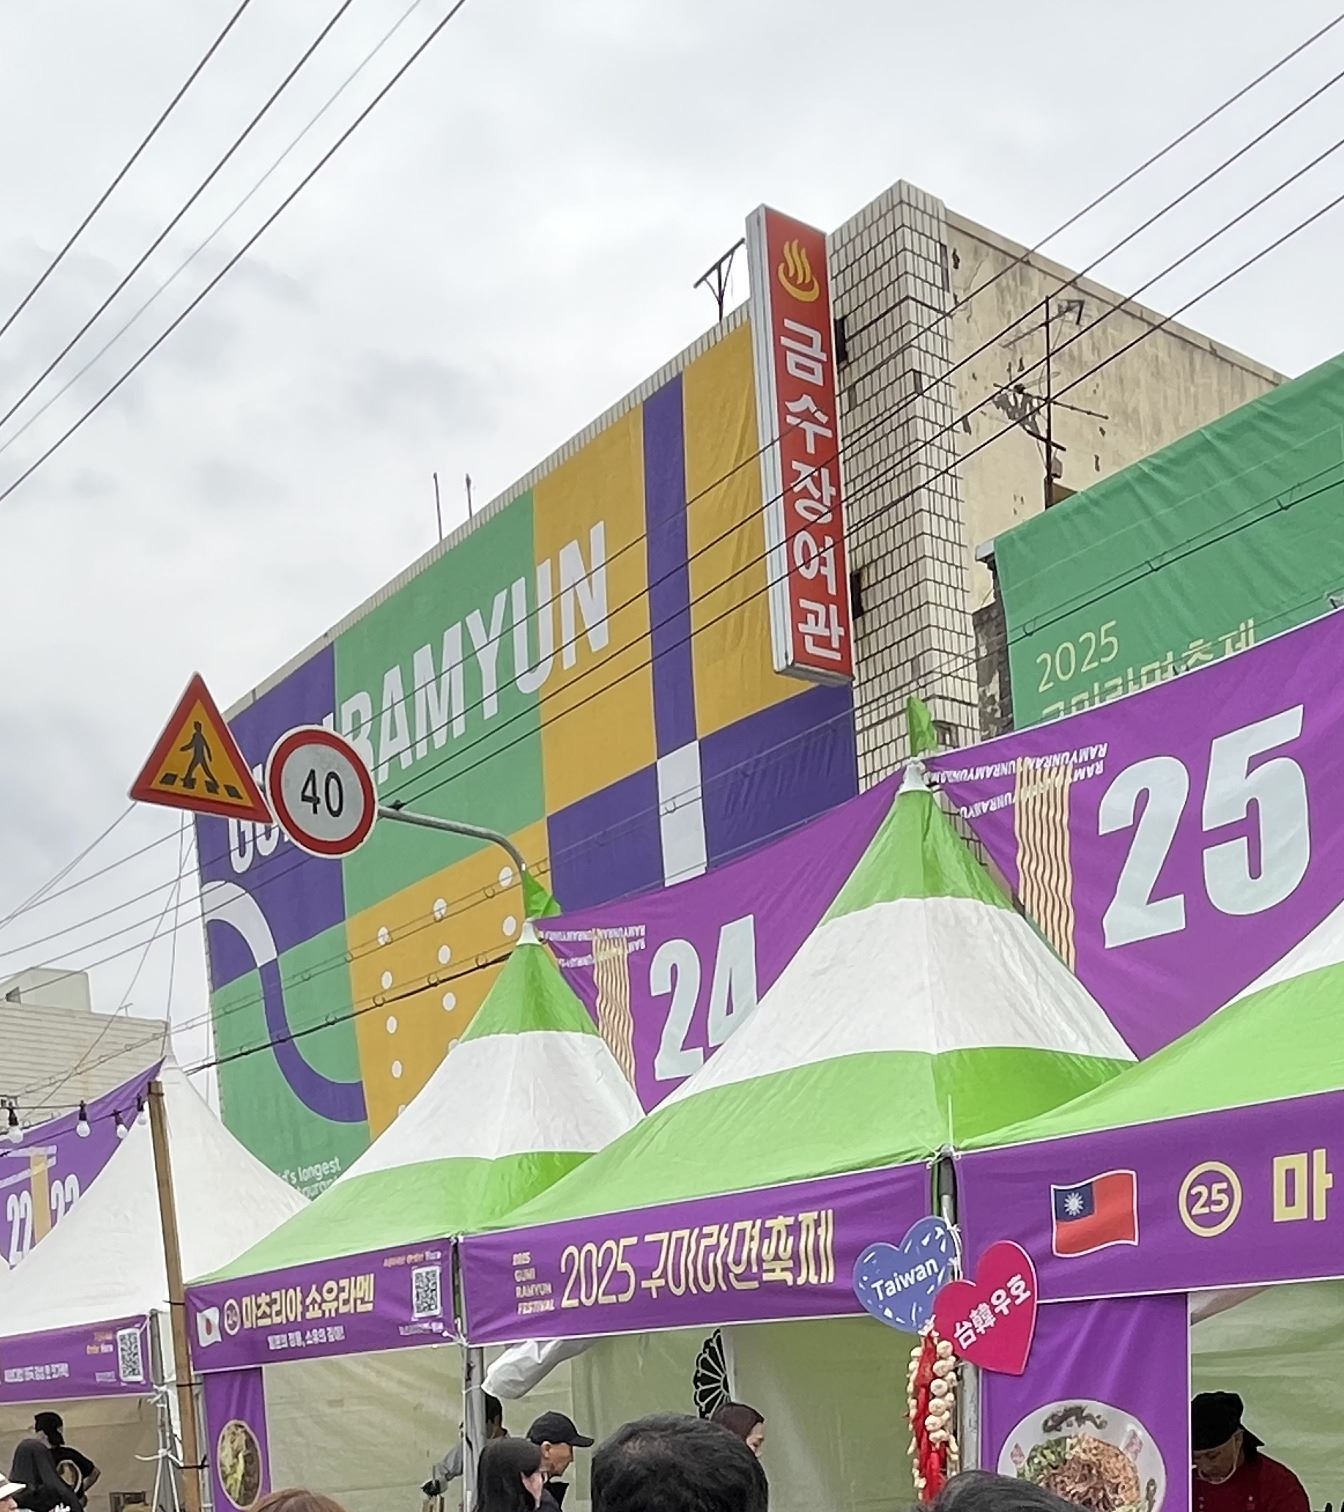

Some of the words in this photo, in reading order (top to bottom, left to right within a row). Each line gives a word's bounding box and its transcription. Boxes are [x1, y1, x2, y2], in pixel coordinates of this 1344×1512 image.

[779, 317, 845, 662] 금수장여관
[341, 520, 610, 786] RAMYUN
[1036, 620, 1119, 693] 2025
[301, 768, 344, 818] 40
[1096, 704, 1312, 949] 25
[651, 914, 757, 1082] 24
[297, 1156, 342, 1183] longest
[1189, 1181, 1231, 1217] 25
[560, 1236, 638, 1309] 2025
[641, 1208, 835, 1300] 구미라면축제
[871, 1257, 940, 1302] Taiwan
[242, 1284, 304, 1330] 마츠리야
[305, 1272, 376, 1320] 쇼유라멘
[518, 1298, 556, 1315] FESTIVAL
